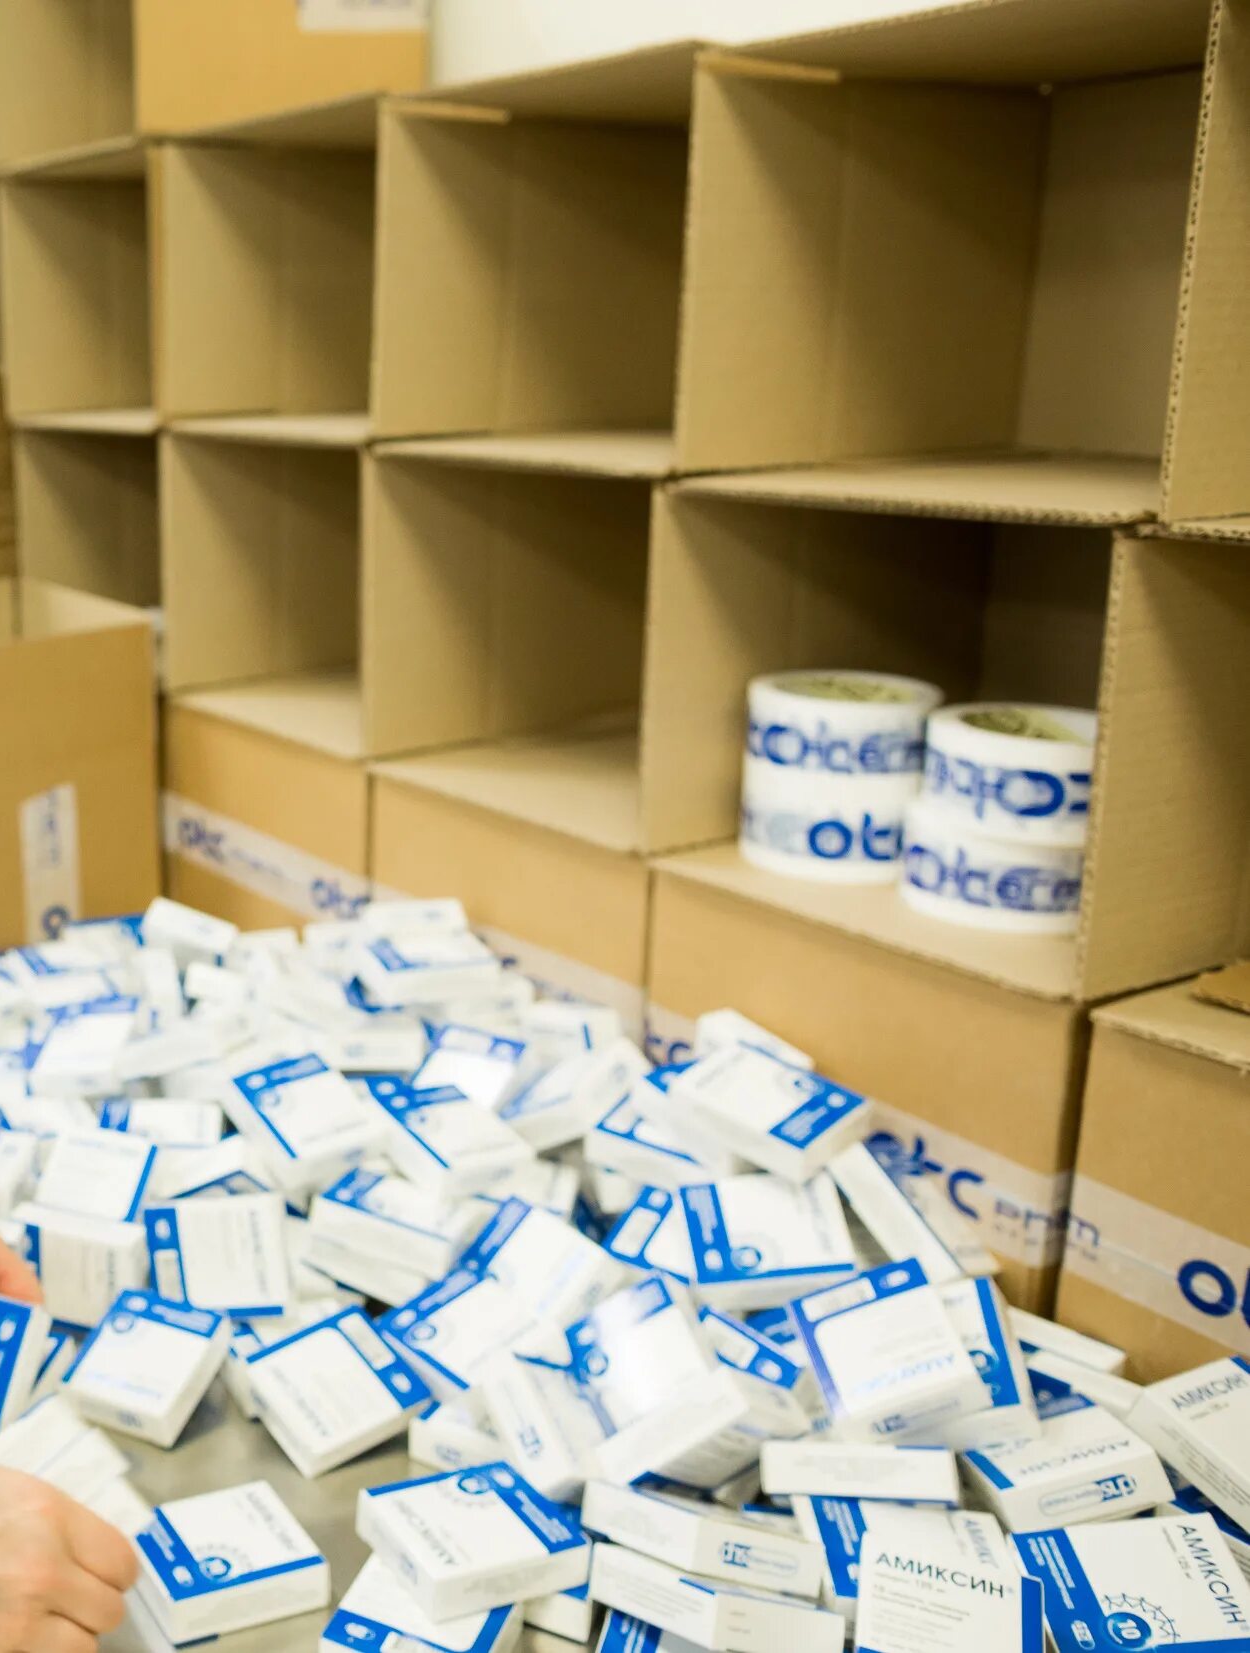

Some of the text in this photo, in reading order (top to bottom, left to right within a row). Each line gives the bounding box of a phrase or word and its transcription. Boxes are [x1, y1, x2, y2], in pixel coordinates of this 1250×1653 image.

[875, 1552, 1004, 1599] АМИКСИН
[1175, 1523, 1246, 1625] АМИКСИН
[1117, 1618, 1142, 1641] 10
